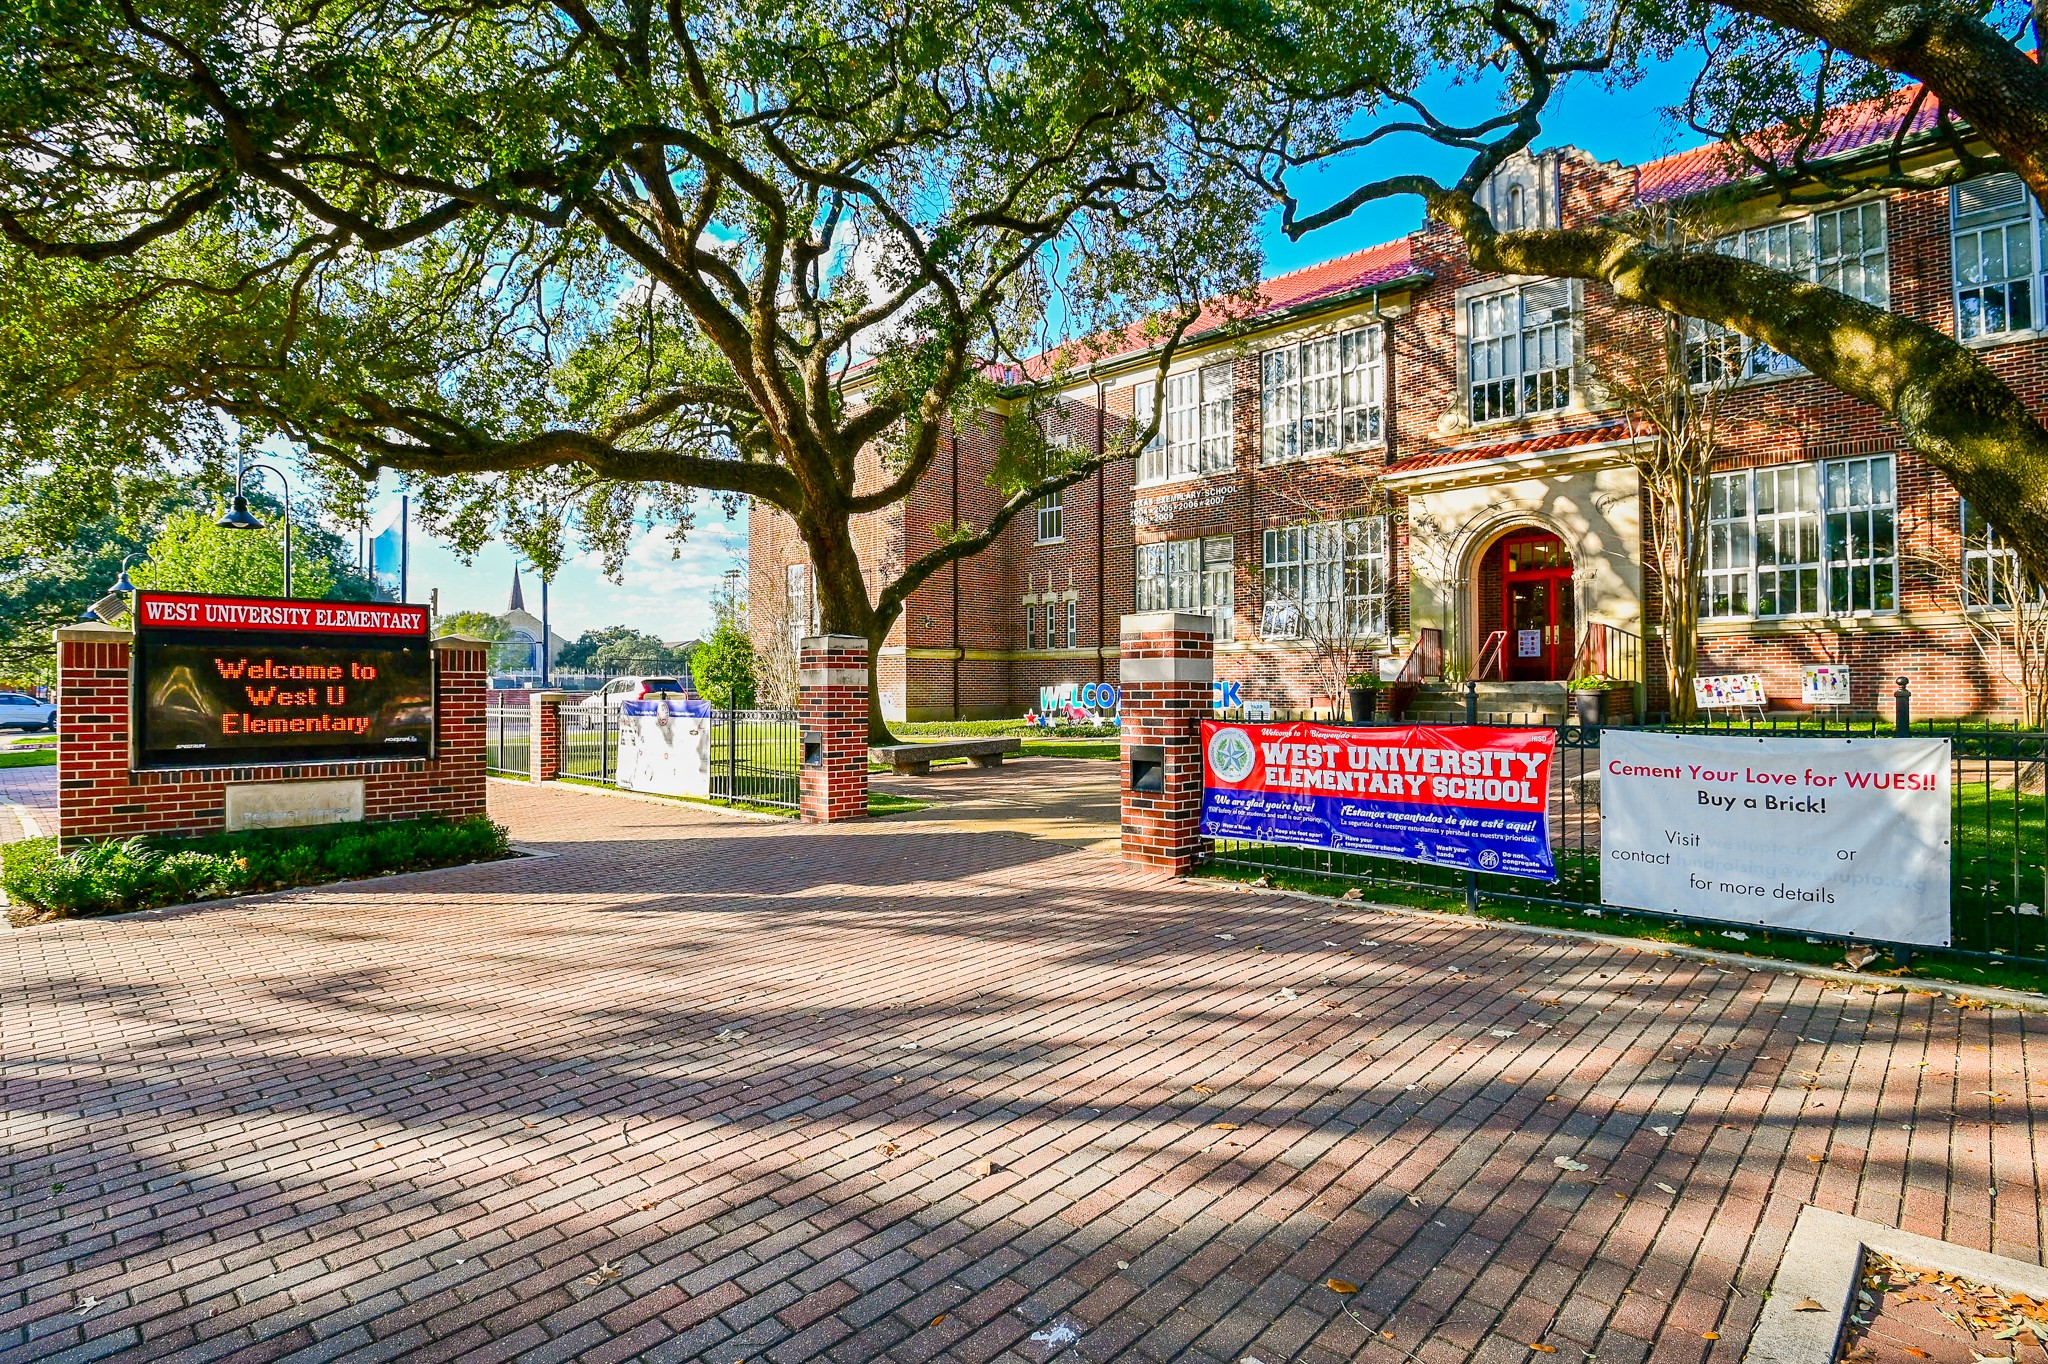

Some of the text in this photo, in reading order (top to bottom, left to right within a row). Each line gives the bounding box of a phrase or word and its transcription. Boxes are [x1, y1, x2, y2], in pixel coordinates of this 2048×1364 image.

[1130, 485, 1238, 509] TEXAS EXEMPLARY SCHOOL
[1130, 496, 1225, 517] 2004 2005 2006 2007
[1154, 512, 1174, 522] 2009
[146, 601, 422, 630] WEST UNIVERSITY ELEMENTARY
[214, 658, 377, 680] Welcome to
[245, 686, 345, 706] West U
[222, 712, 371, 735] Elementary
[1261, 727, 1292, 737] Welcome
[1293, 729, 1301, 737] to
[1310, 729, 1350, 739] Bienvenido
[1261, 742, 1546, 779] WEST UNIVERSITY
[1264, 766, 1539, 804] ELEMENTARY SCHOOL
[1608, 760, 1936, 791] Cement Your Love for WUES!!
[1214, 794, 1315, 813] We are glad you're here!
[1697, 790, 1826, 814] Buy a Brick!
[1246, 810, 1267, 818] students
[1277, 812, 1288, 820] staff
[1340, 805, 1537, 833] ¡Estamos encantados de que esté aquí!
[1275, 828, 1289, 836] Keep
[1308, 831, 1323, 839] apart
[1348, 819, 1374, 829] seguridad
[1382, 823, 1407, 831] nuestros
[1407, 825, 1440, 834] estudiantes
[1445, 828, 1470, 837] personal
[1480, 832, 1504, 840] nuestra
[1505, 834, 1537, 843] prioridad.
[1345, 841, 1381, 851] temperature
[1380, 845, 1405, 853] checked
[1436, 844, 1469, 854] Wash your
[1664, 829, 1700, 847] Visit
[1836, 849, 1857, 861] or
[1502, 858, 1540, 868] congregate
[1512, 852, 1524, 860] not
[1611, 849, 1670, 865] contact
[1690, 872, 1835, 904] for more details
